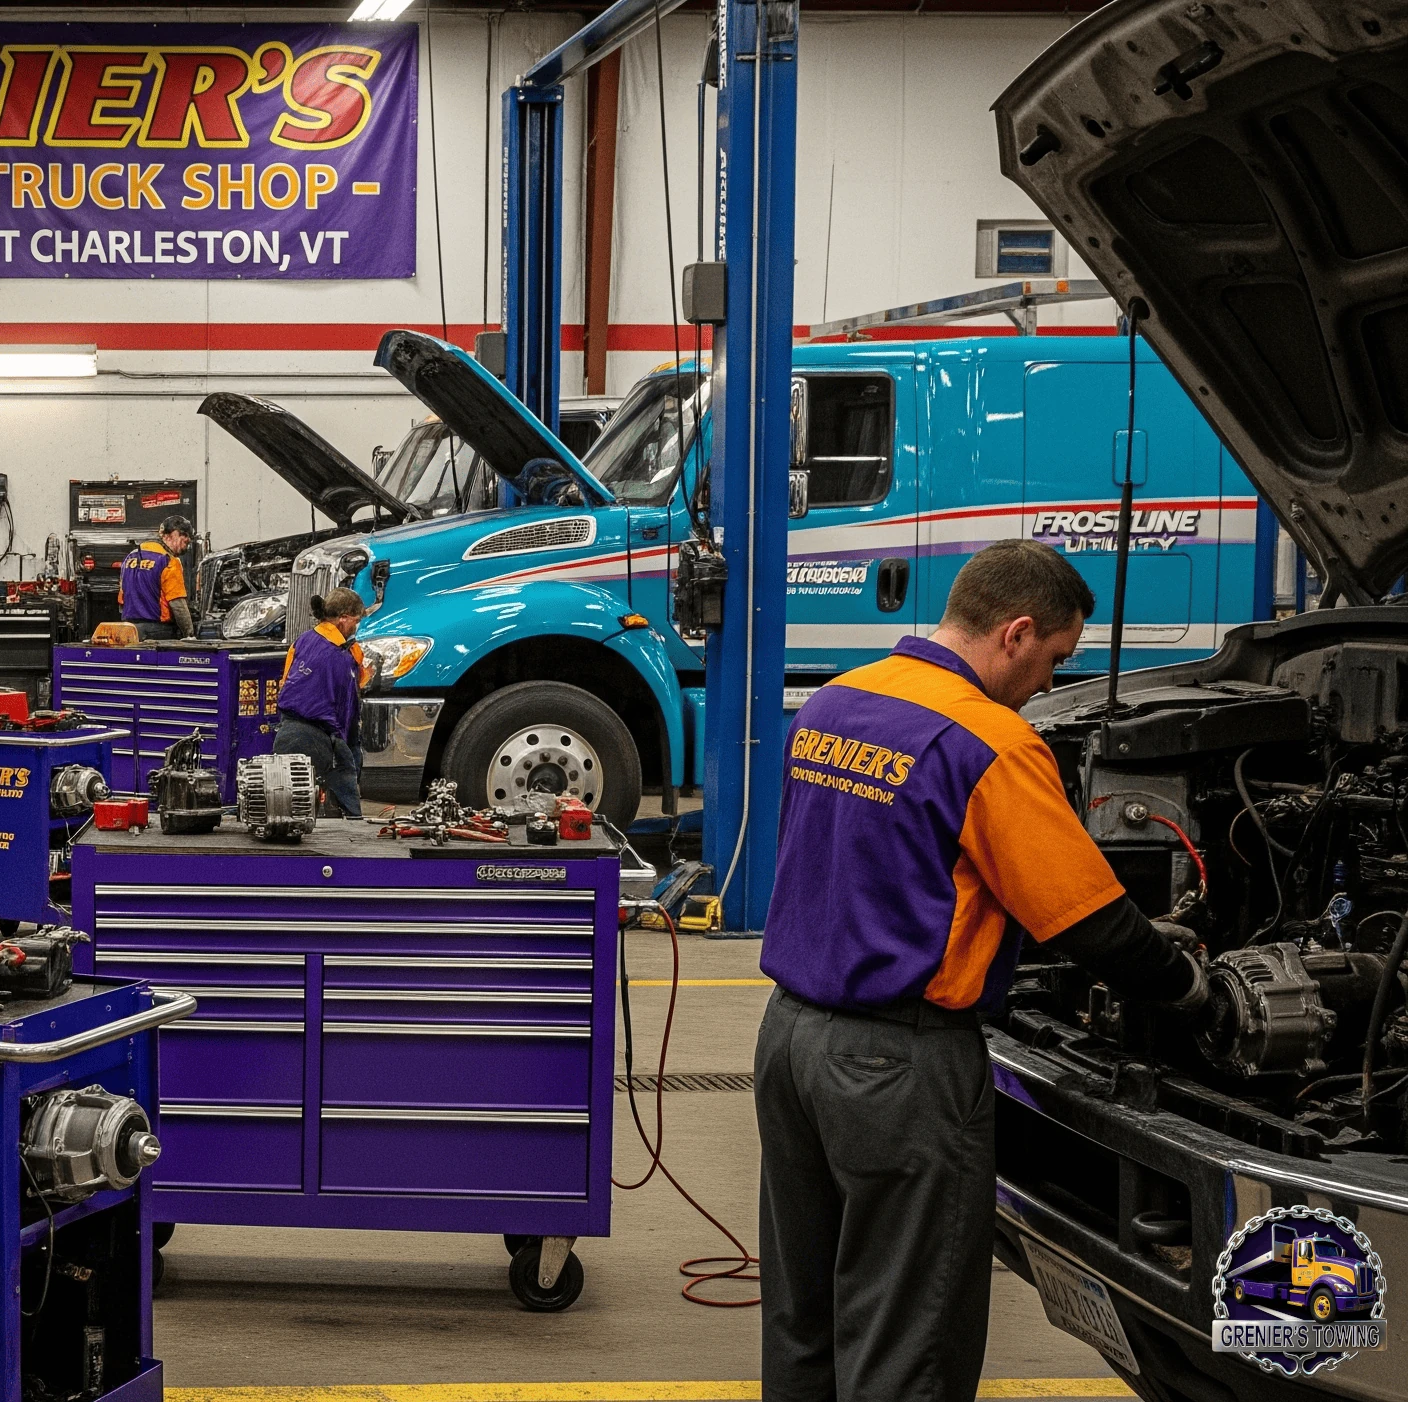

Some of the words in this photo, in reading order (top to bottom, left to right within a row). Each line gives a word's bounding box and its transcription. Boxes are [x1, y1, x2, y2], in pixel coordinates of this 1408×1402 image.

[181, 162, 338, 210] SHOP
[30, 228, 291, 271] CHARLESTON,
[300, 230, 349, 264] VT
[791, 727, 916, 786] GRENIER'S
